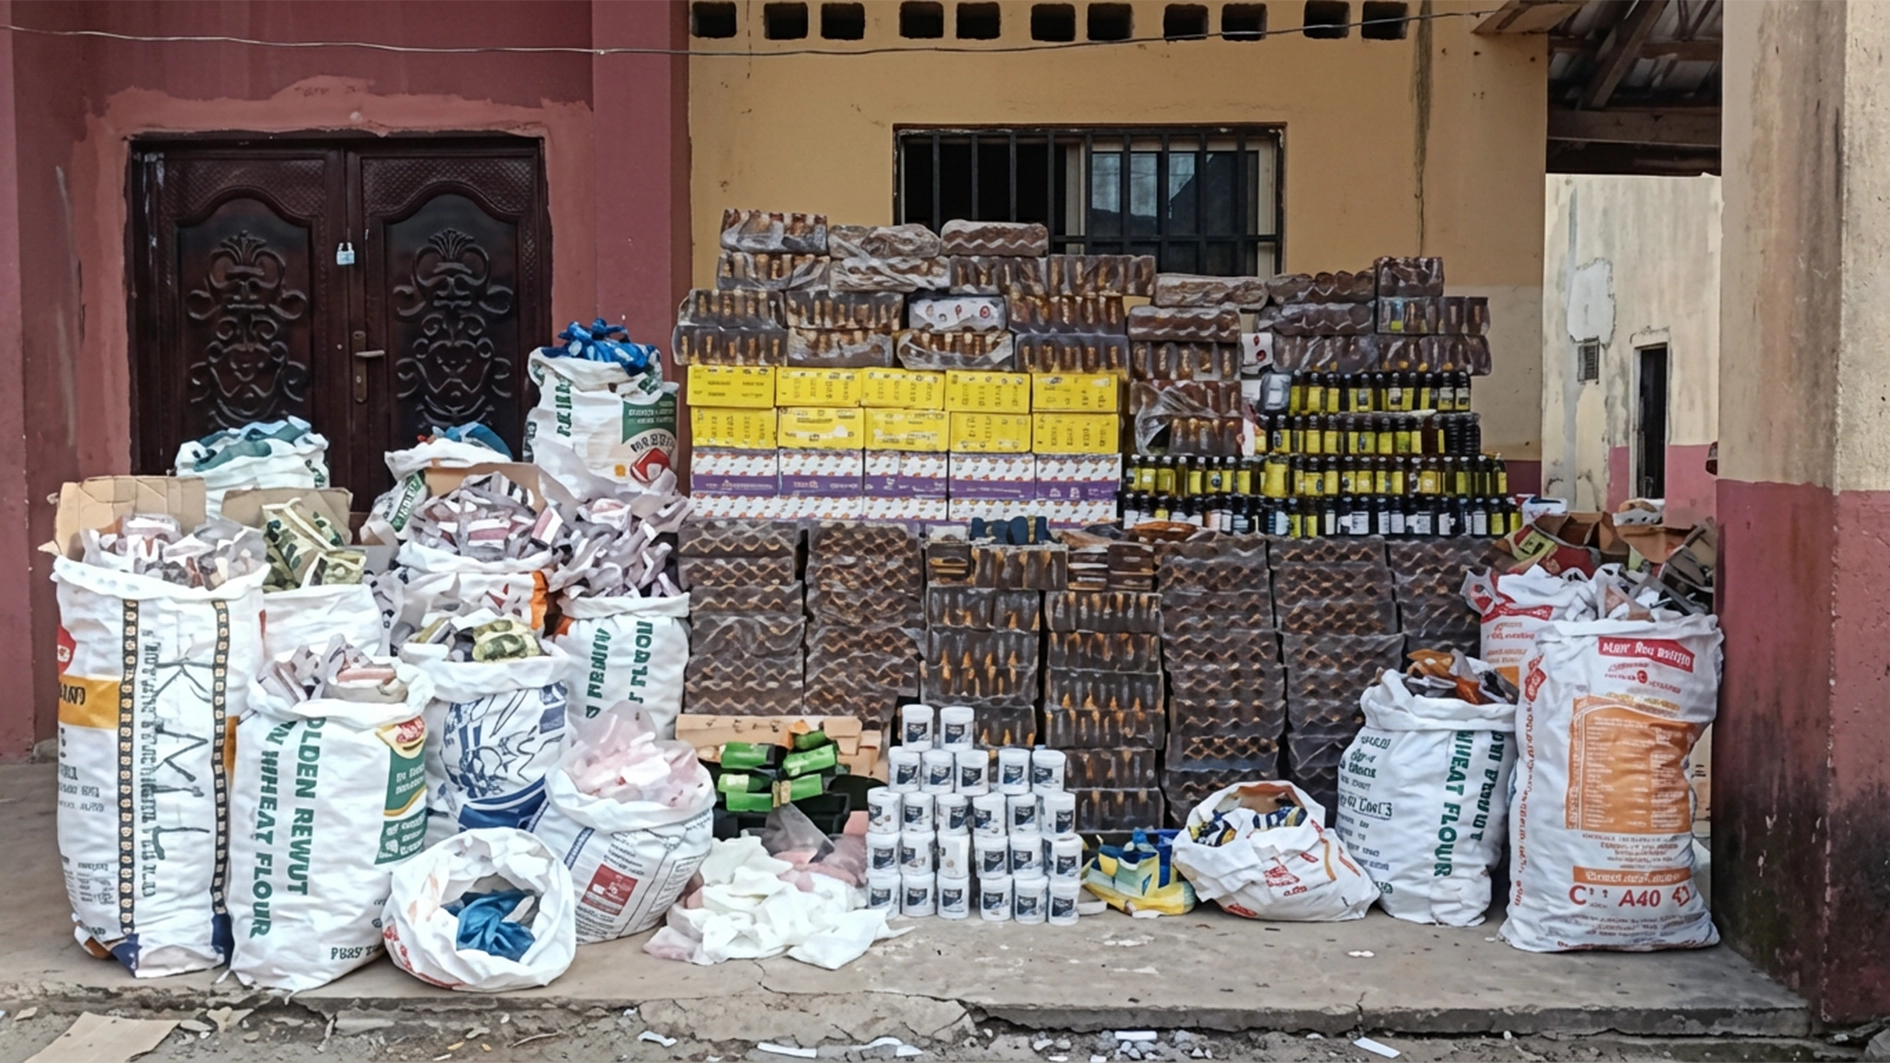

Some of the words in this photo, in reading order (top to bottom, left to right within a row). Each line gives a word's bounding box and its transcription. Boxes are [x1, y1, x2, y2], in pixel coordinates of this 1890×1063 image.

[255, 751, 279, 845] WHEAT
[249, 852, 273, 939] FLOUR
[1618, 889, 1661, 907] A40
